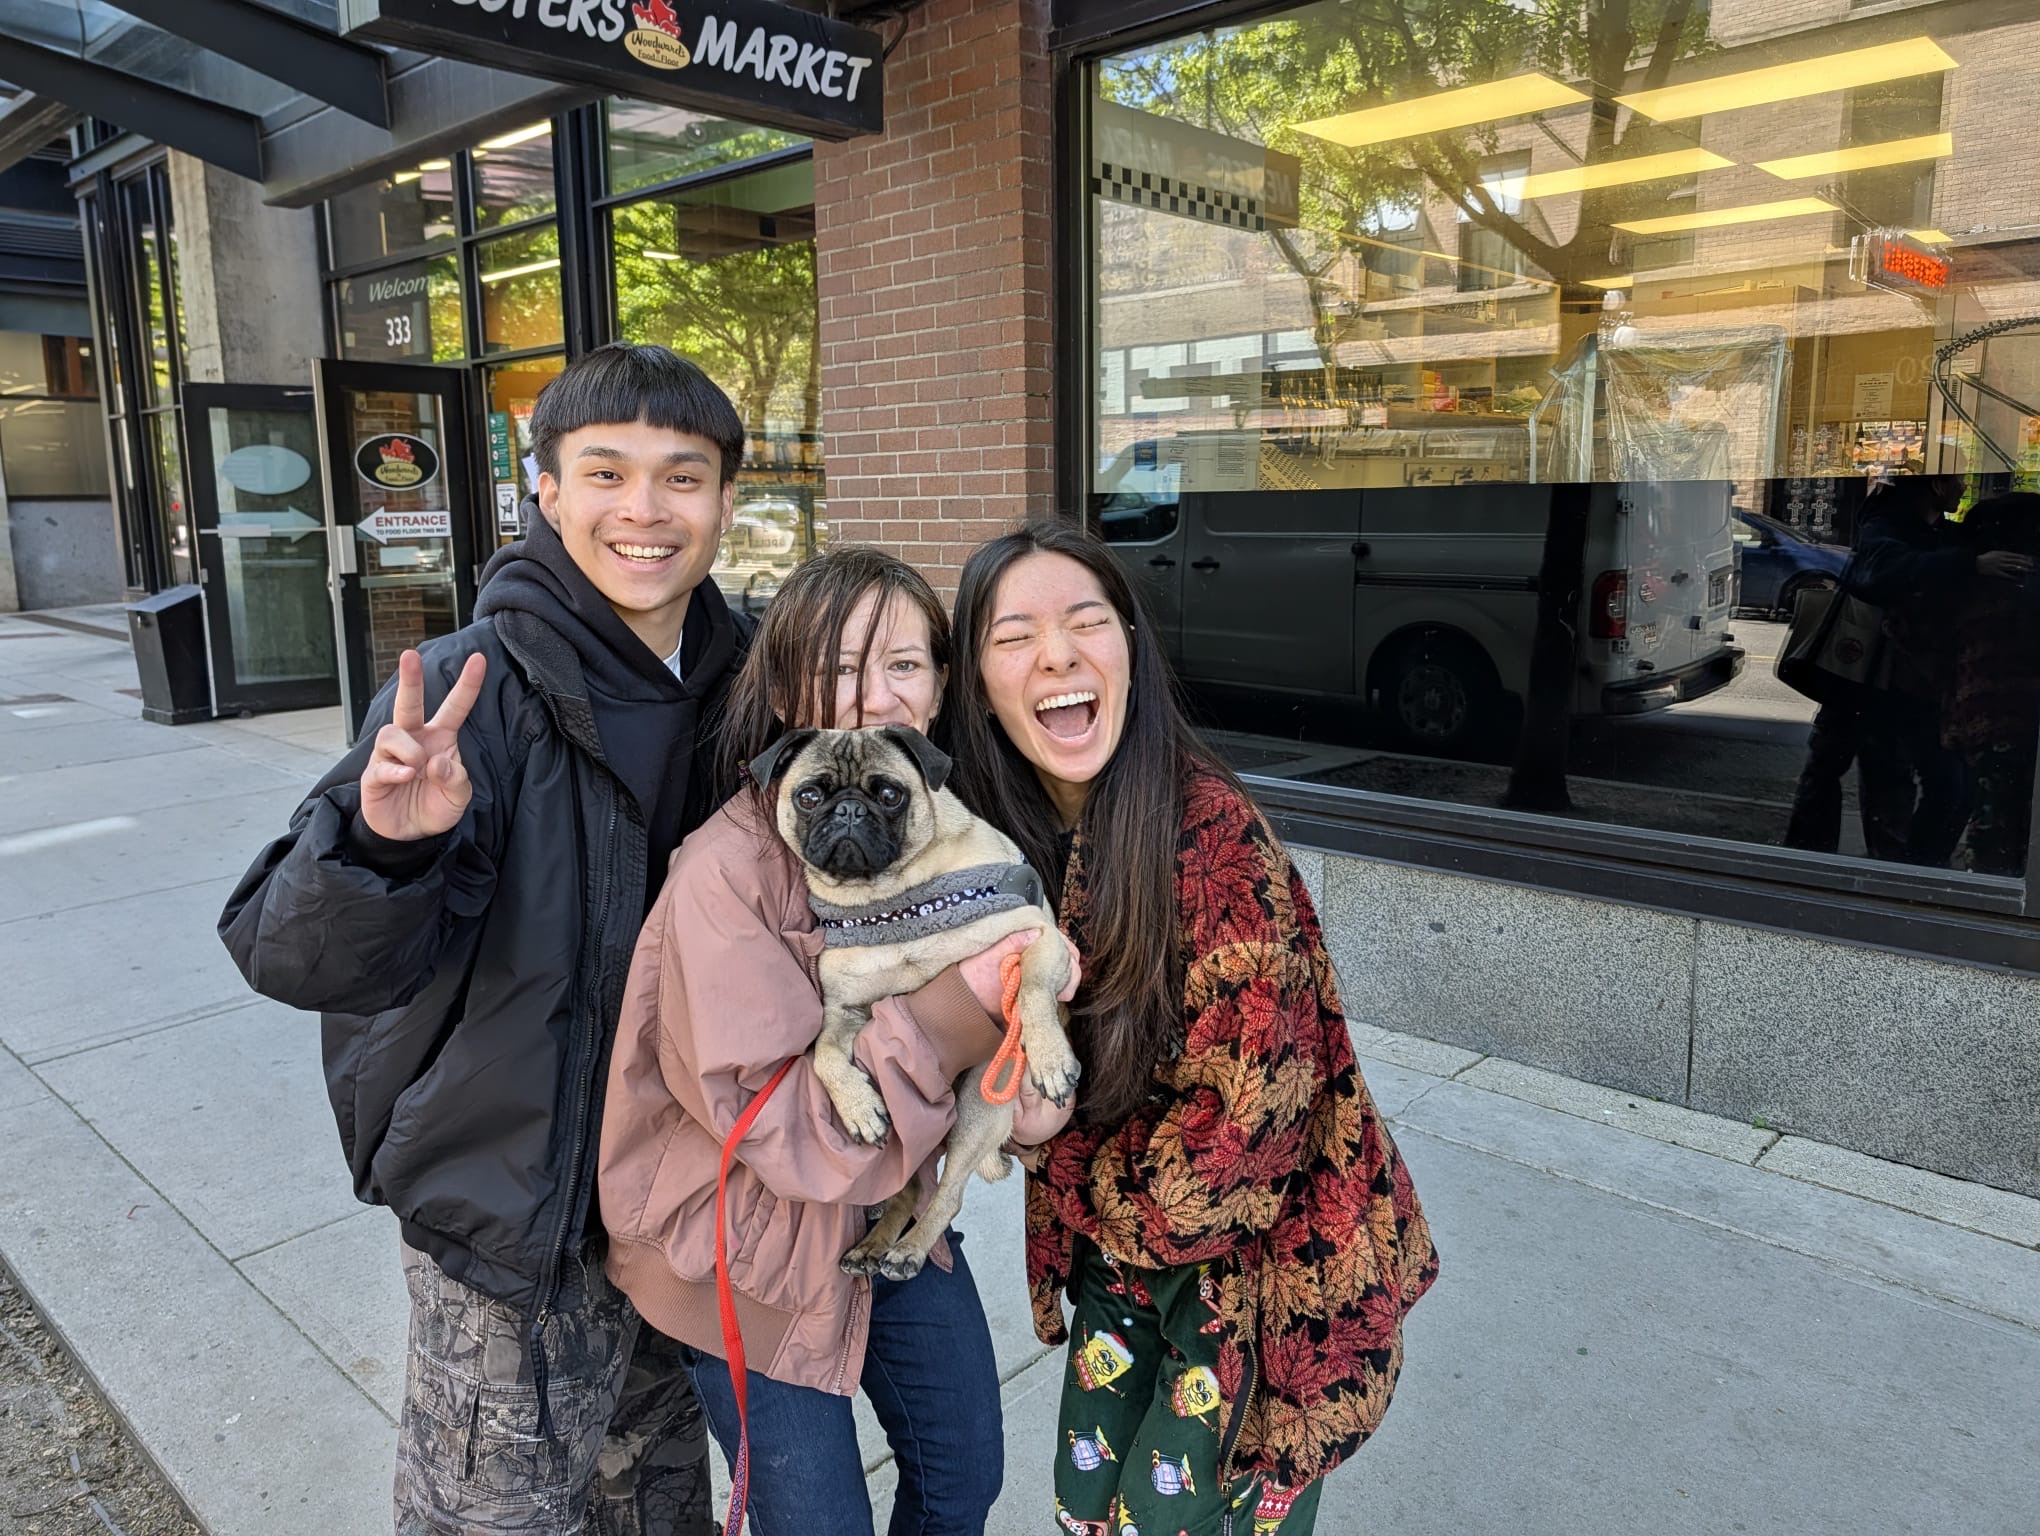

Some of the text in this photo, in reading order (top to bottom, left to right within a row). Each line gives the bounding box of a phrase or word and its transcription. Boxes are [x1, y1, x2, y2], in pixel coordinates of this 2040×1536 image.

[693, 14, 872, 102] MARKET
[385, 315, 412, 347] 333
[375, 515, 447, 527] ENTRANCE
